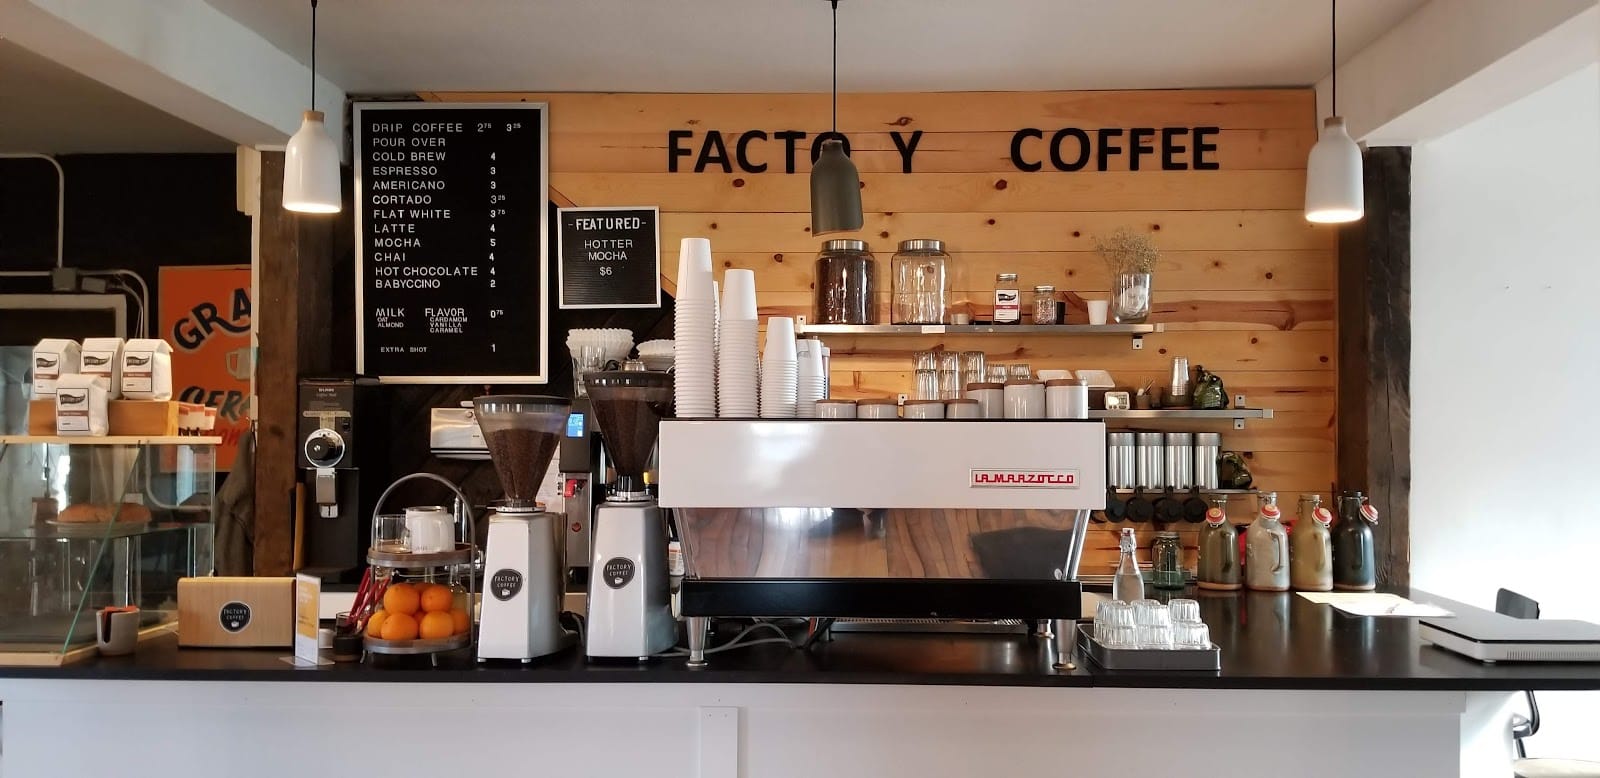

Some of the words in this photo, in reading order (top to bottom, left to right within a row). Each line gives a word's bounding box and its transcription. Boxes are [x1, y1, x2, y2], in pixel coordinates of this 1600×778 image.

[373, 123, 402, 132] DRIP
[413, 123, 463, 132] COFFEE
[373, 138, 405, 146] POUR
[412, 138, 446, 146] OVER
[1010, 127, 1219, 172] COFFEE
[373, 152, 405, 161] COLD
[411, 152, 446, 161] BREW
[490, 152, 497, 160] 4
[373, 167, 437, 175] ESPRESSO
[489, 167, 497, 175] 3
[373, 181, 445, 190] AMERICANO
[490, 181, 497, 189] 3
[373, 195, 431, 204] CORTADO
[374, 210, 404, 218] FLAT
[410, 210, 450, 218] WHITE
[375, 224, 415, 233] LATTE
[489, 224, 496, 232] 4
[375, 239, 421, 247] MOCHA
[489, 239, 497, 247] 5
[585, 240, 633, 248] HOTTER
[375, 253, 405, 261] CHAI
[488, 253, 495, 261] 4
[589, 252, 627, 260] MOCHA
[376, 267, 399, 276] HOT
[403, 267, 478, 276] CHOCOLATE
[489, 267, 496, 275] 4
[600, 267, 612, 276] $6
[376, 280, 440, 288] BABYCCINO
[489, 280, 497, 288] 2
[376, 308, 404, 317] MILK
[425, 308, 464, 316] FLAVOR
[490, 344, 496, 352] 1
[975, 474, 988, 483] LA
